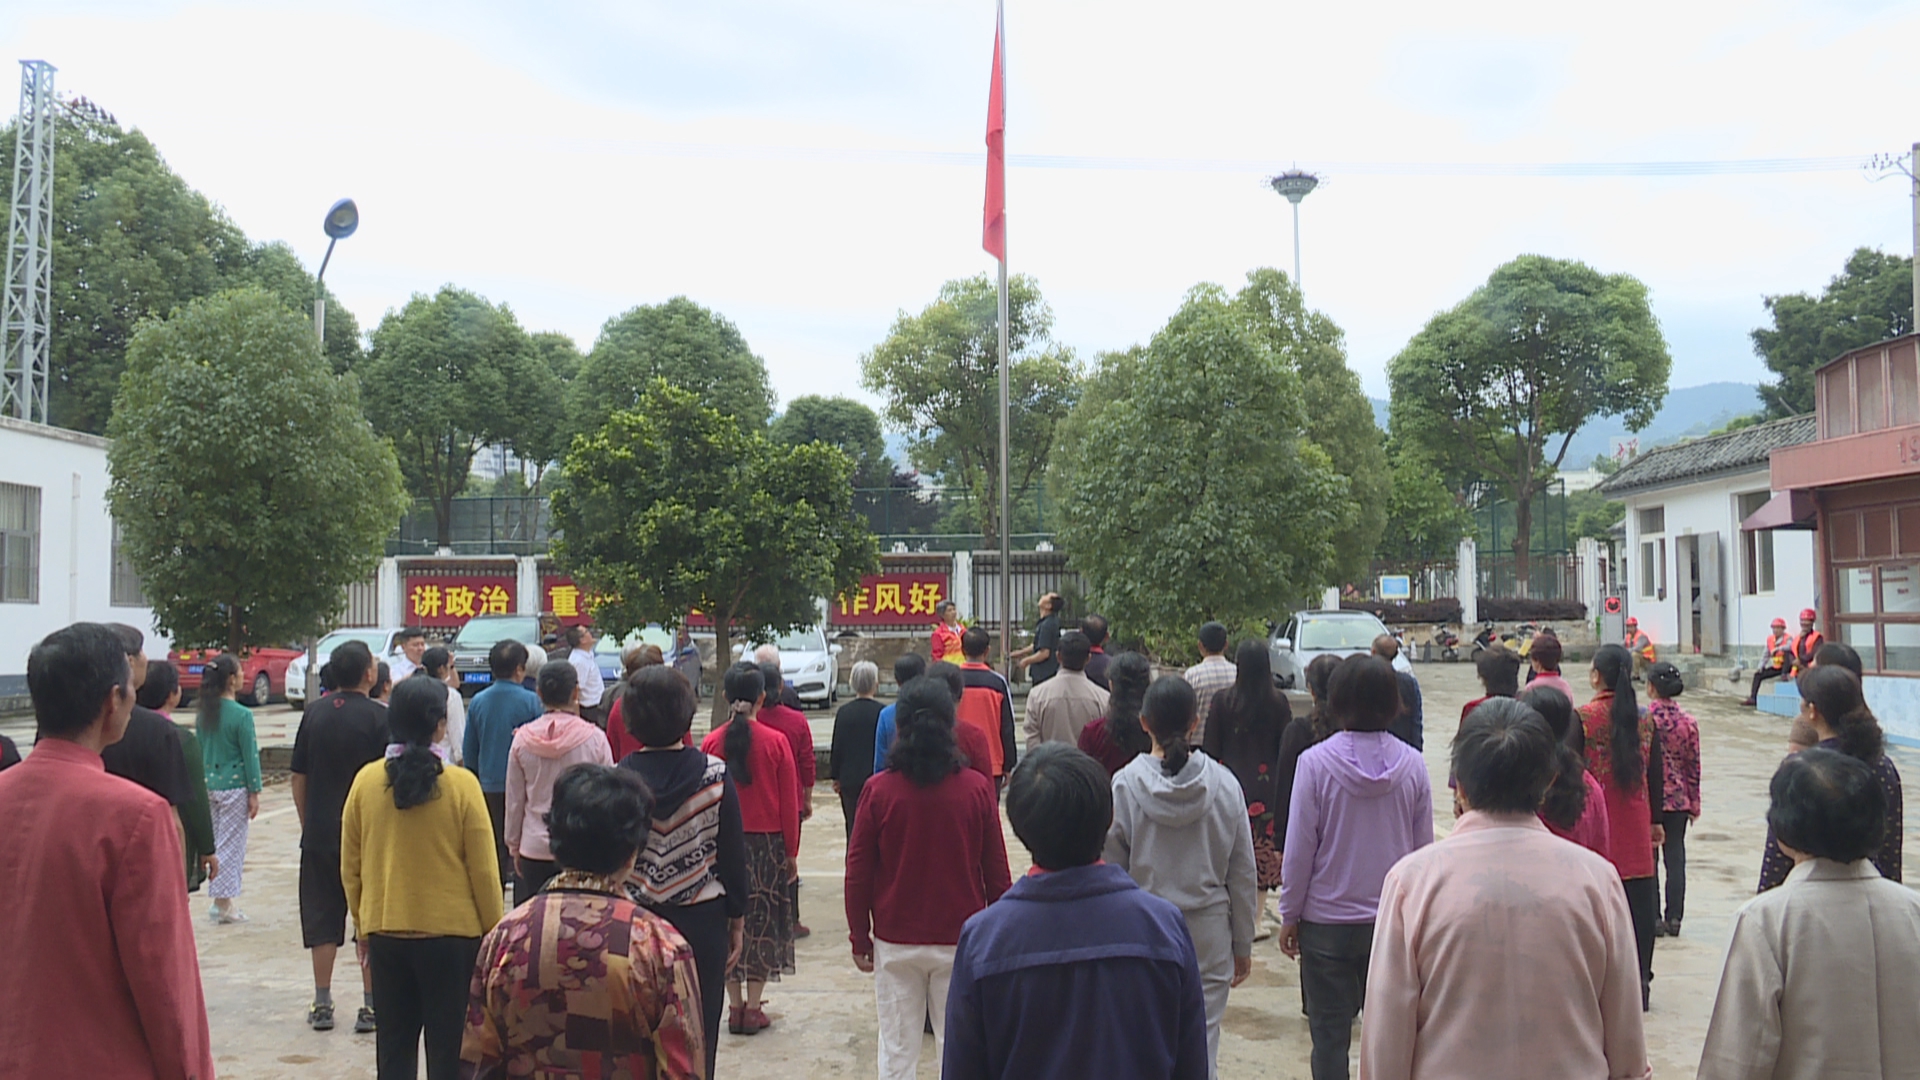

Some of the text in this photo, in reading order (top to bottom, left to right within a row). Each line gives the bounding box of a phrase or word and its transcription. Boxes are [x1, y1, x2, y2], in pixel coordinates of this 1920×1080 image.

[410, 584, 510, 617] 讲政治
[838, 582, 942, 616] 作风好
